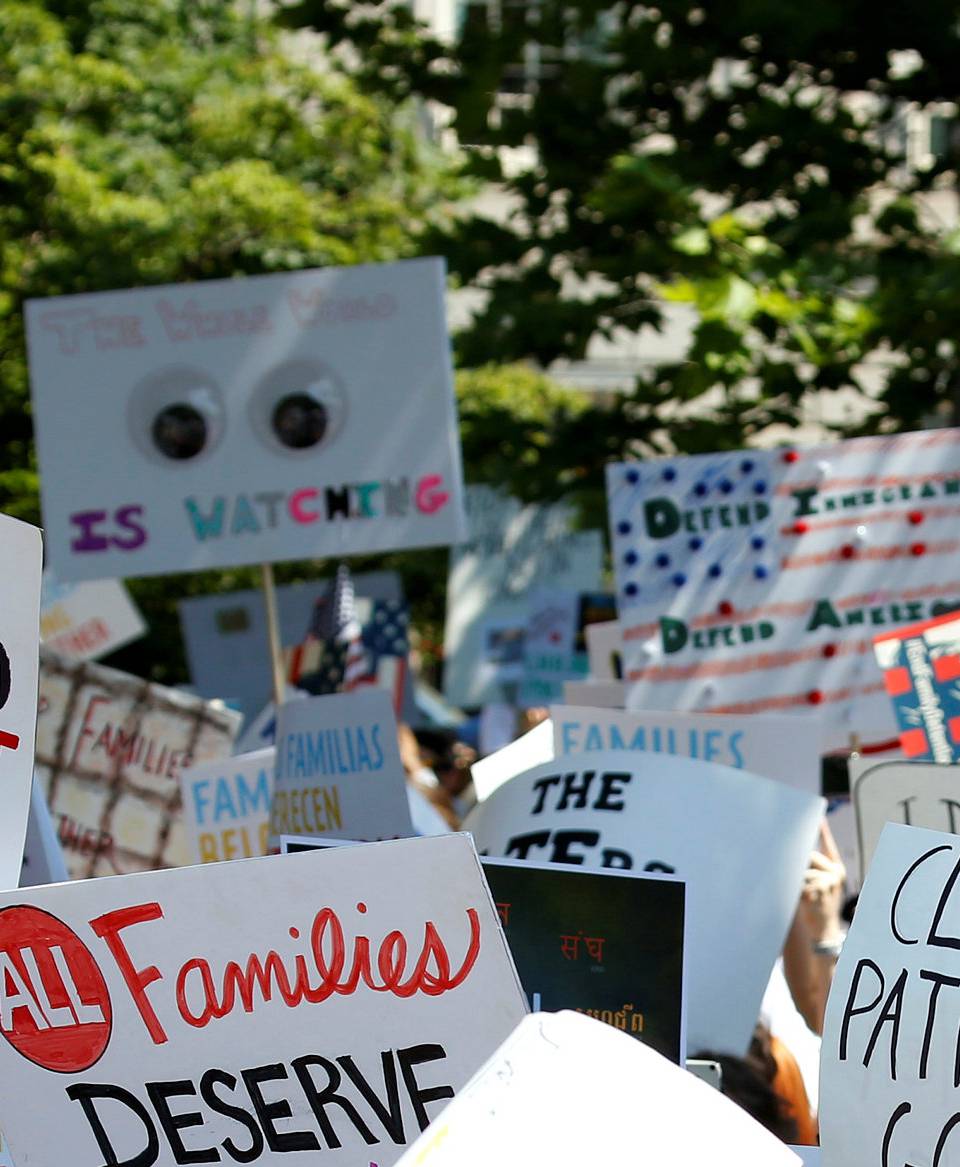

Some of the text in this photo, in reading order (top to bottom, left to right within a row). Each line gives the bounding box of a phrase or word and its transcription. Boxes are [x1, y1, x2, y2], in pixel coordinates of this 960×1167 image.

[69, 473, 451, 554] IS WATCHING
[531, 769, 633, 816] THE
[0, 902, 482, 1045] ALL Families
